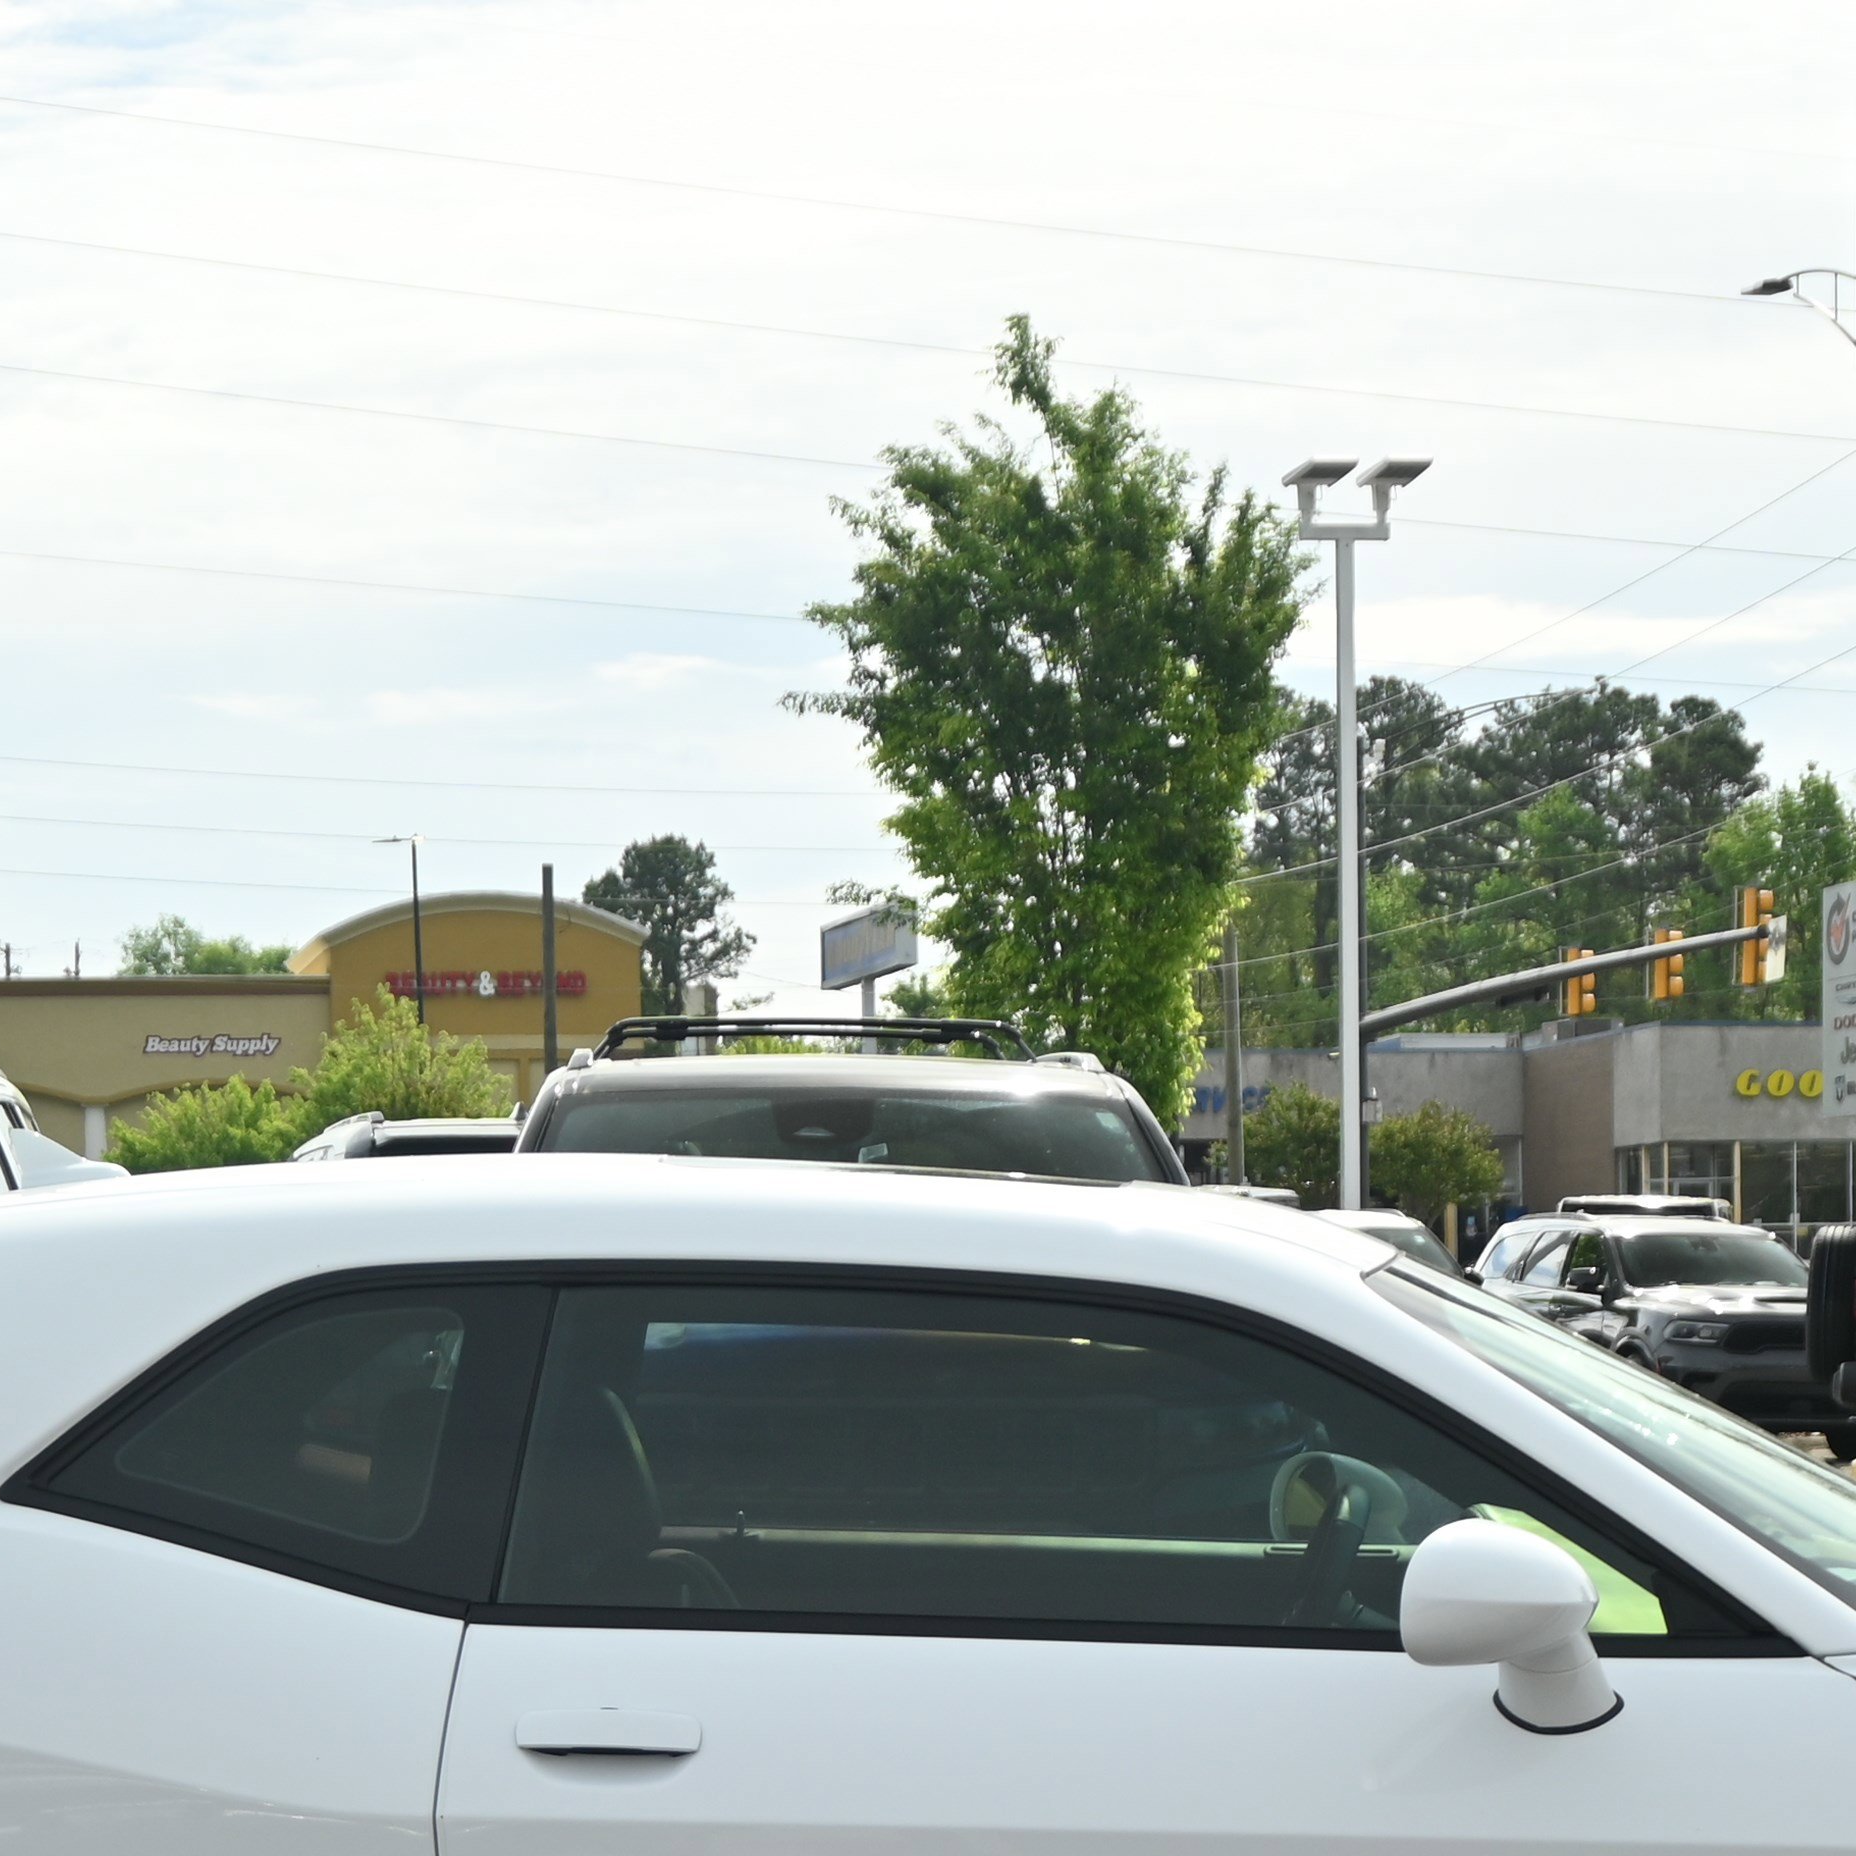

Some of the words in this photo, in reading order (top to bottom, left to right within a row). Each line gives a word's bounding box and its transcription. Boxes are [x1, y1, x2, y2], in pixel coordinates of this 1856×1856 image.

[479, 970, 495, 996] &
[497, 971, 587, 997] BEYND
[144, 1034, 211, 1057] Beauty
[212, 1033, 281, 1057] Supply
